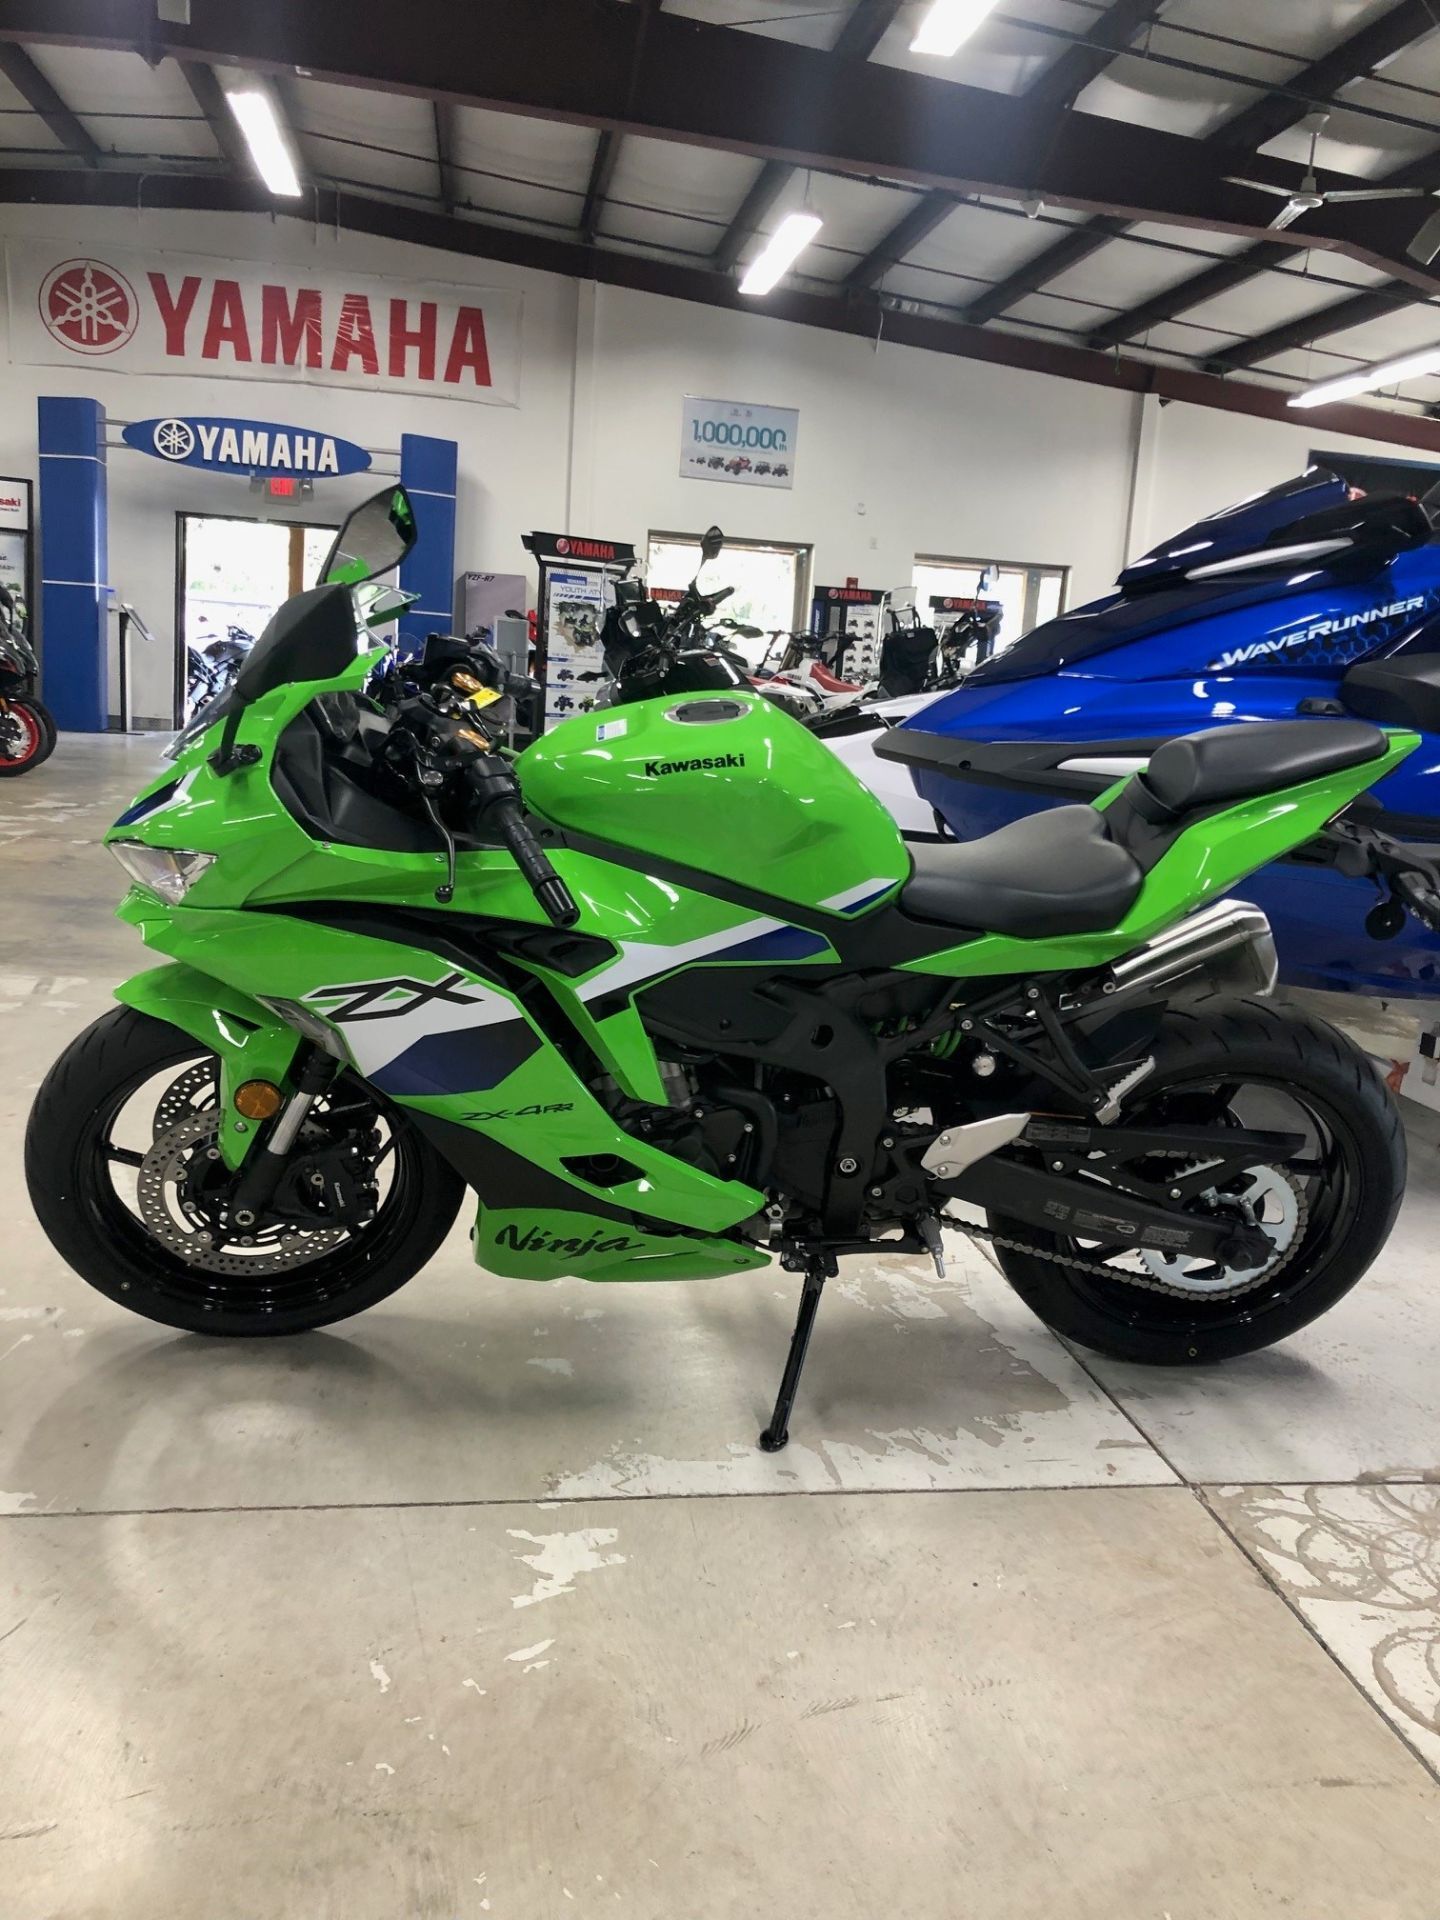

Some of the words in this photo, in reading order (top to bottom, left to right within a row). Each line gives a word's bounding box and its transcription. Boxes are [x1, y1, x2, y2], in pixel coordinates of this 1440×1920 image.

[147, 271, 493, 388] YAMAHA
[197, 424, 340, 475] YAMAHA
[570, 539, 615, 560] YAMAHA
[560, 585, 587, 594] YOUTH
[644, 753, 746, 778] Kawasaki
[304, 970, 488, 1023] ZX
[494, 1223, 646, 1260] Ninja
